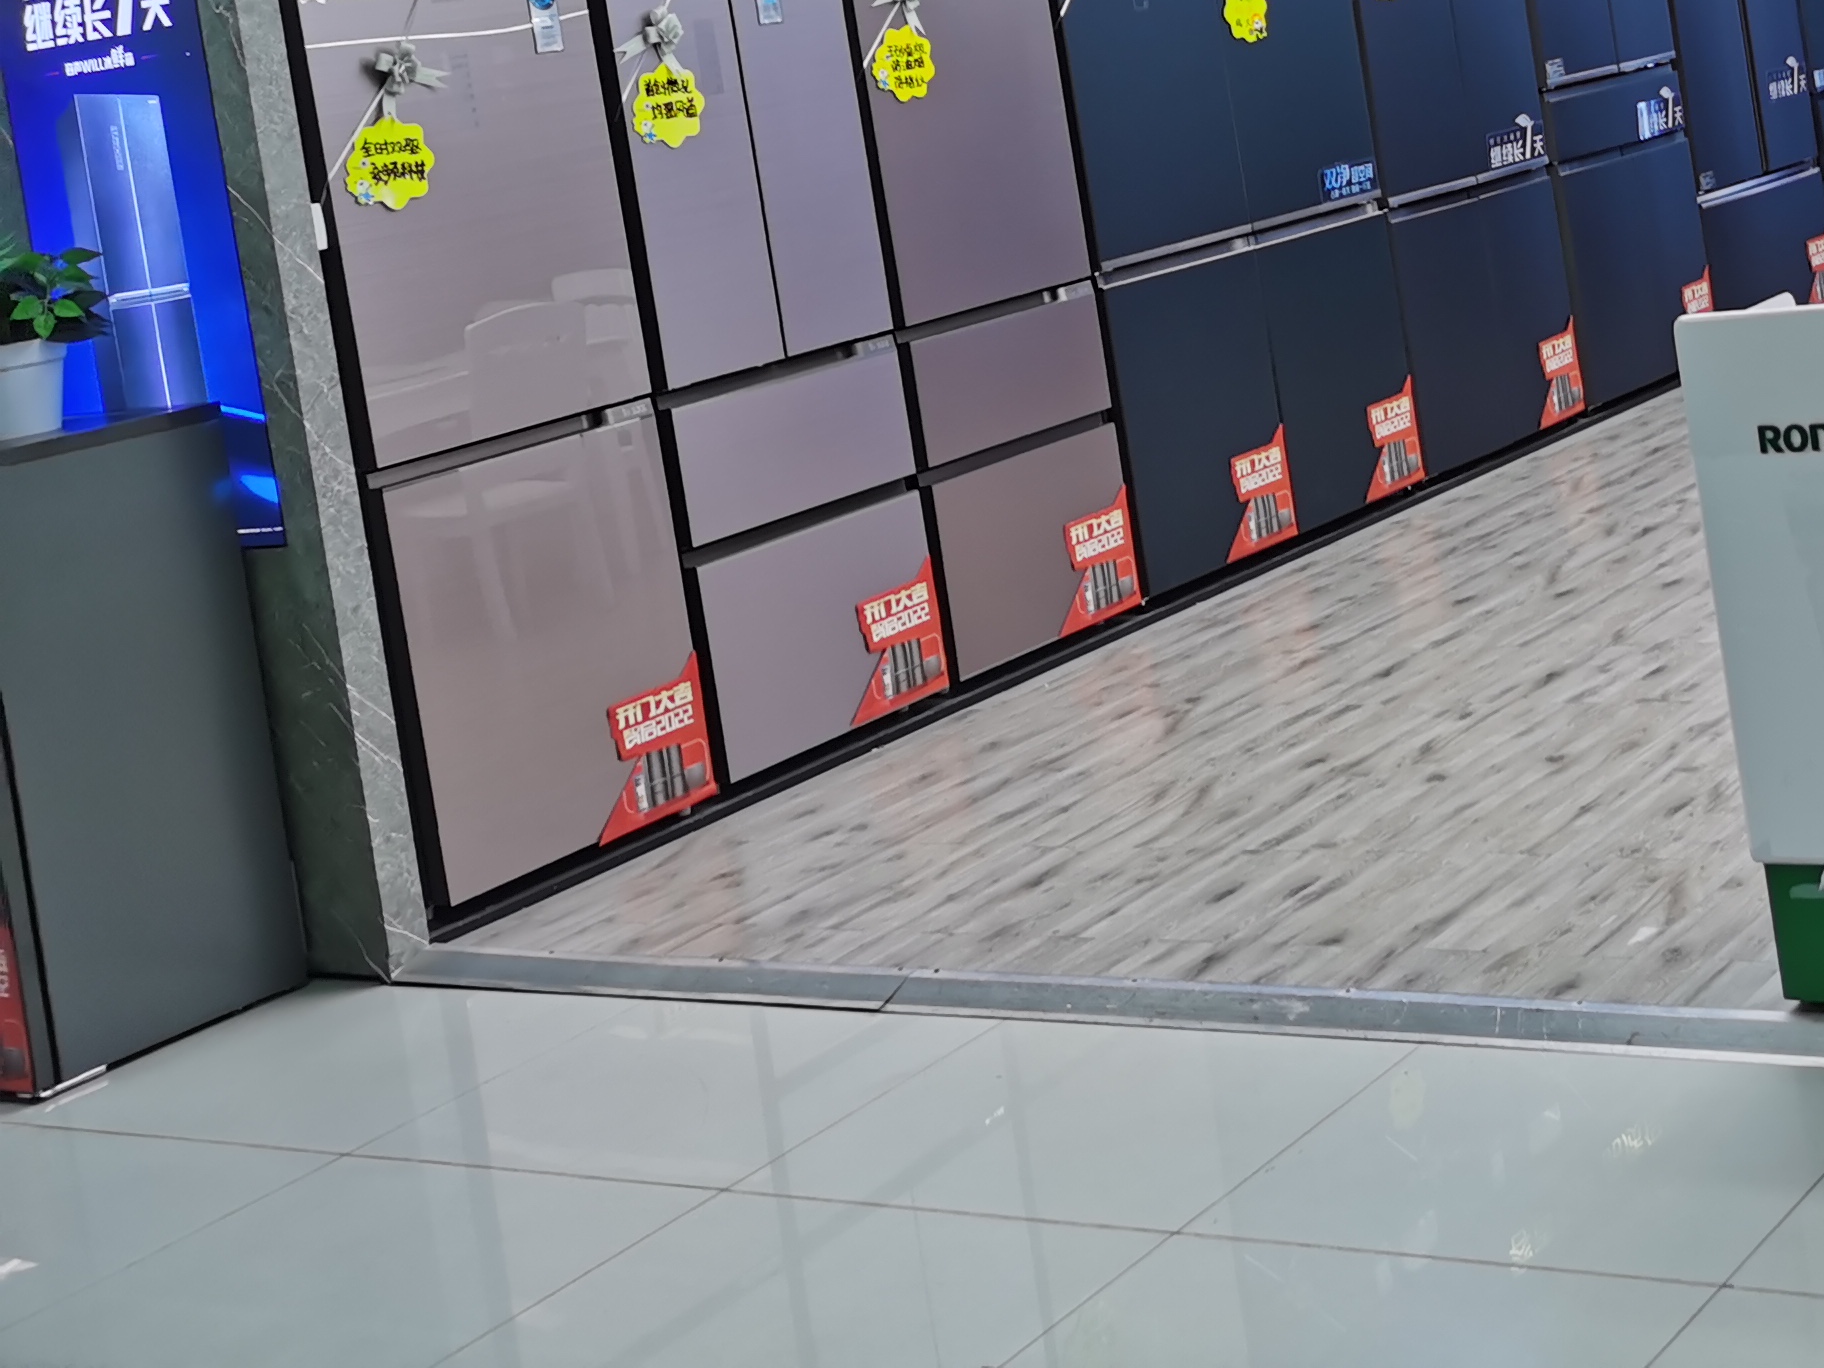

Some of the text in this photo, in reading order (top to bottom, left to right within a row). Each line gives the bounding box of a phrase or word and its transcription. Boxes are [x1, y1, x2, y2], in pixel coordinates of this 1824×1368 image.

[1232, 443, 1283, 480] 开门大吉
[1068, 506, 1125, 549] 开门大吉
[862, 578, 931, 626] 开门大吉
[613, 678, 695, 732] 开门大吉
